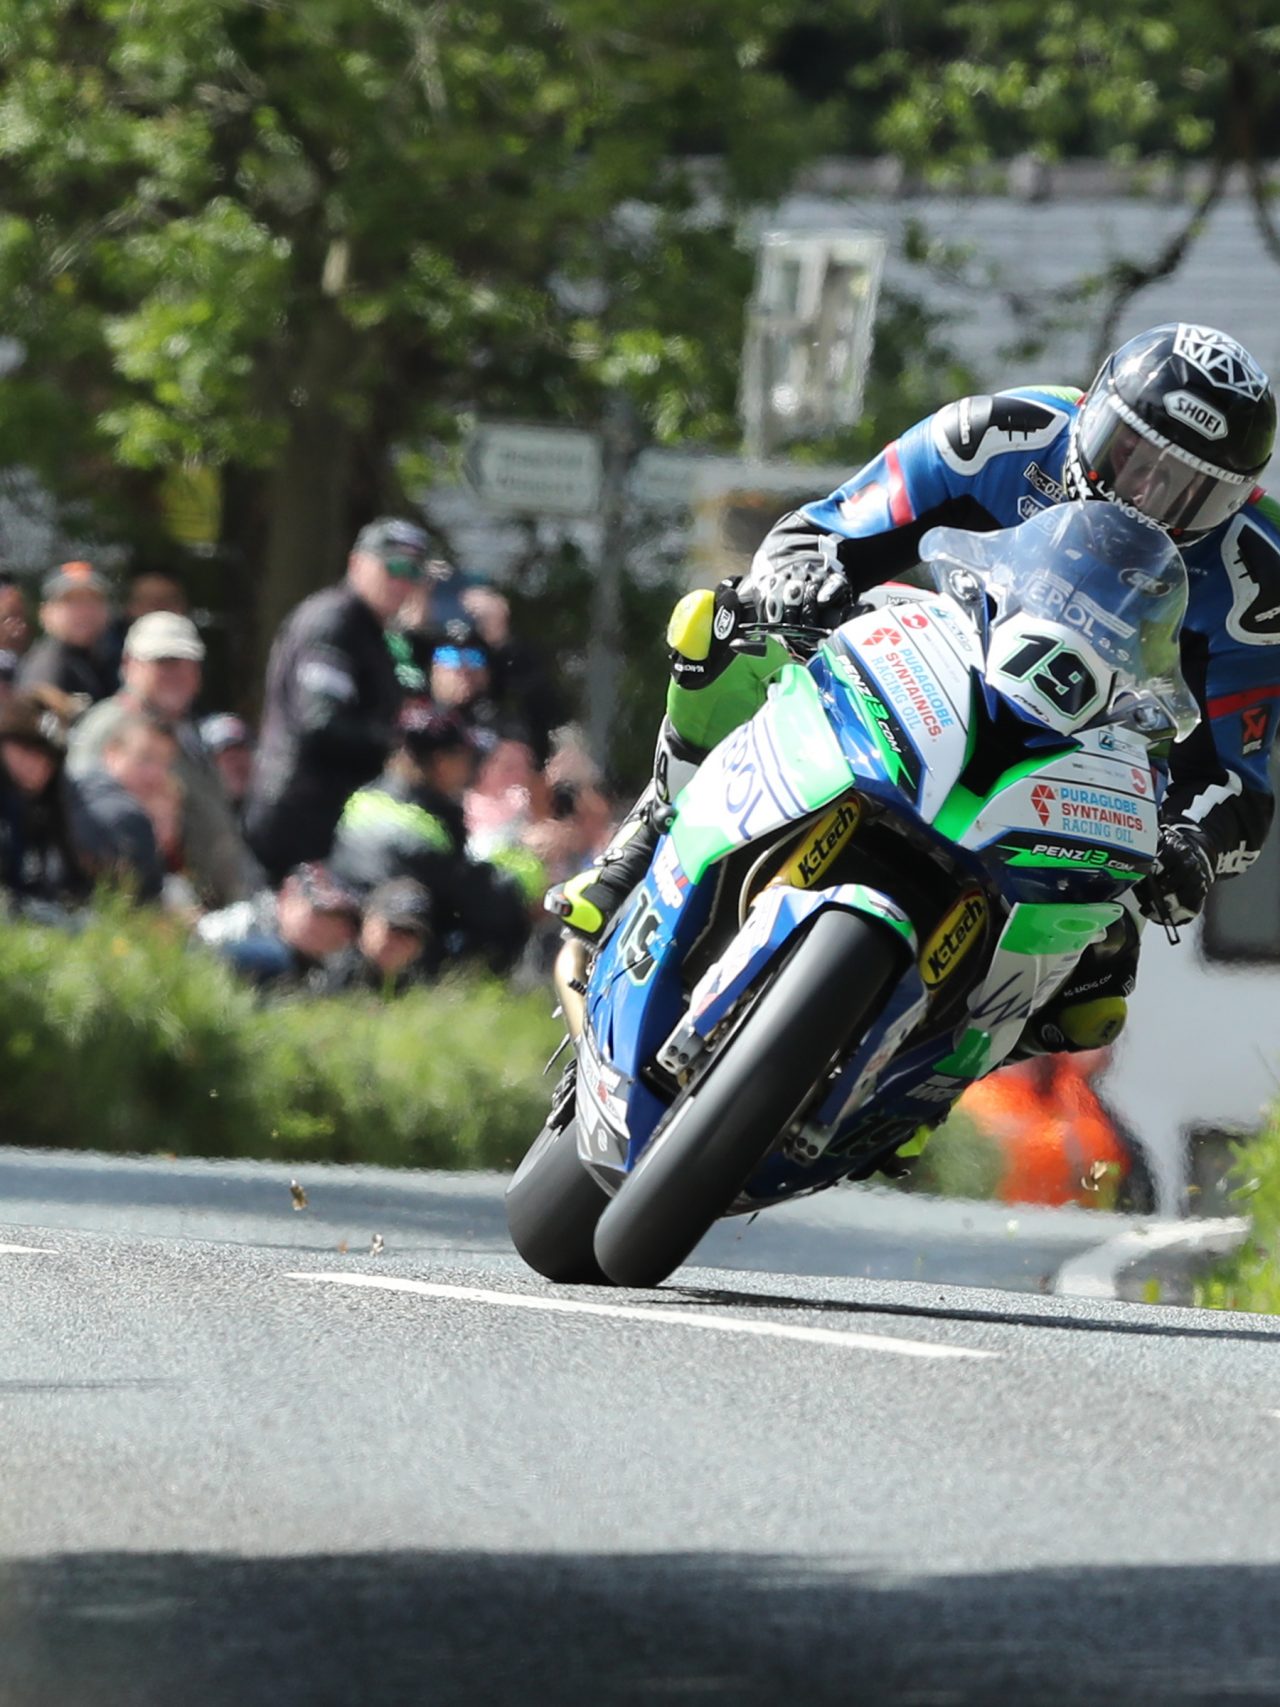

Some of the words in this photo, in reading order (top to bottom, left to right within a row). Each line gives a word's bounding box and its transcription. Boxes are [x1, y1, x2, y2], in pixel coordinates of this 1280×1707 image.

[1181, 343, 1262, 397] MAX
[1173, 397, 1221, 433] SHOEI
[871, 656, 905, 705] RACING
[901, 705, 922, 730] OIL
[900, 647, 954, 728] PURAGLOBE
[998, 632, 1098, 719] 19
[1060, 787, 1138, 816] PURAGLOBE
[1062, 817, 1111, 840] RACING
[1115, 827, 1135, 844] OIL
